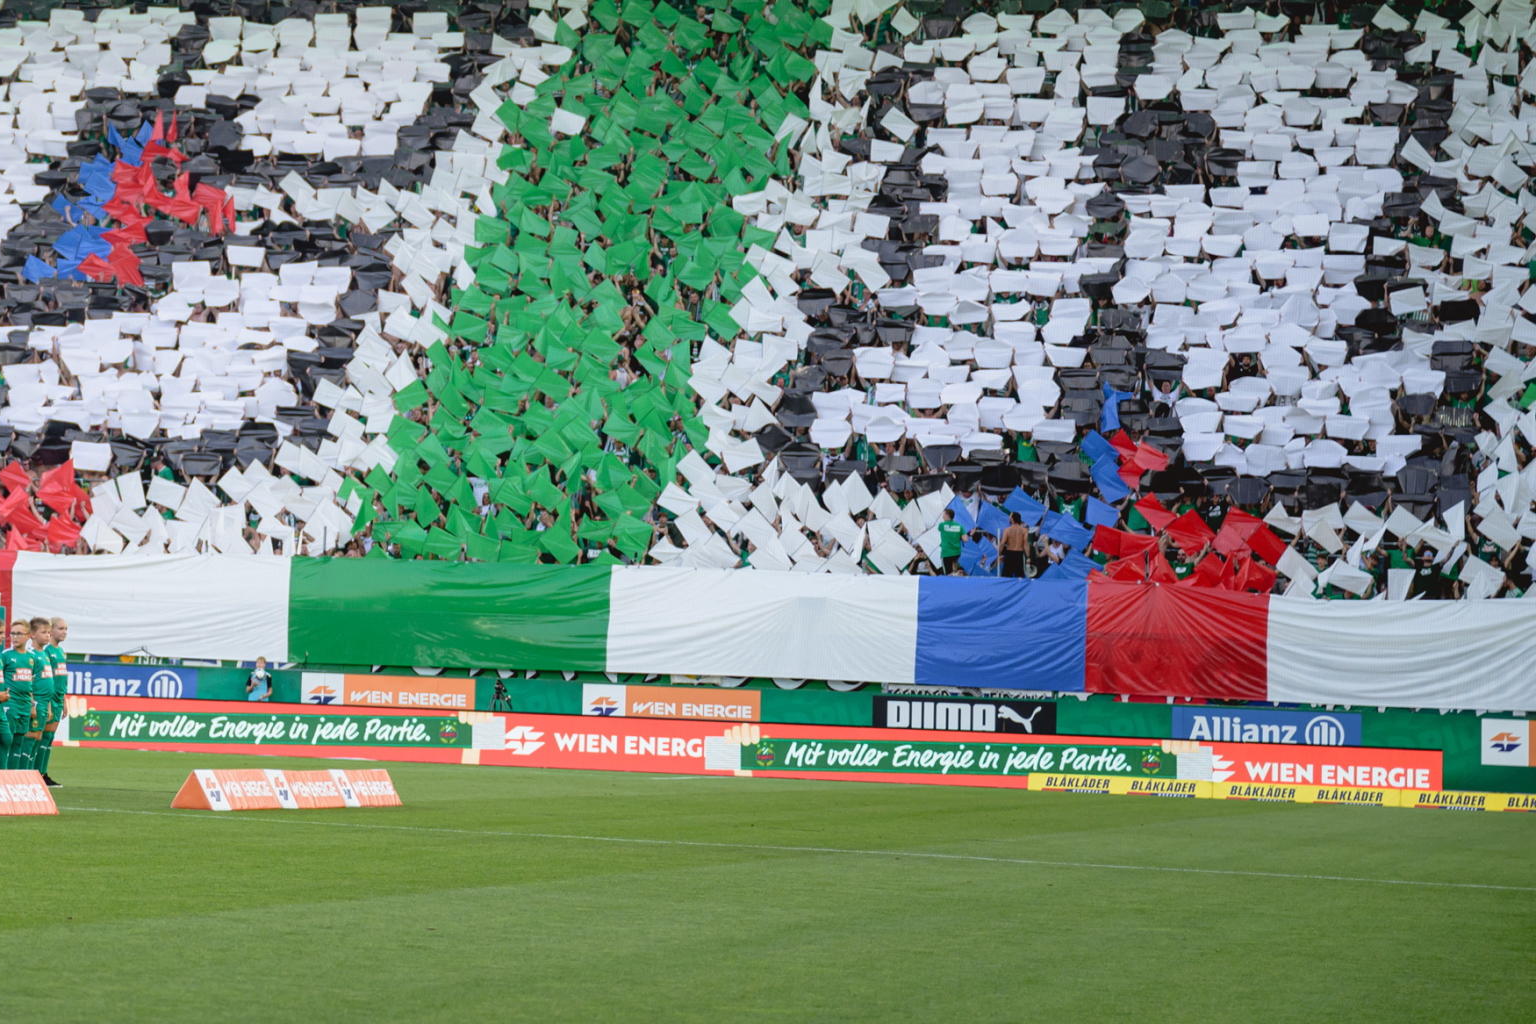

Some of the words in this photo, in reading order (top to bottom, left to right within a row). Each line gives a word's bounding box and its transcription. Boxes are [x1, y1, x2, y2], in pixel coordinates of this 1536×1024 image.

[66, 671, 141, 697] llianz
[350, 689, 391, 704] WIEN
[398, 691, 466, 707] ENERGIE
[632, 701, 676, 715] WIEN
[682, 703, 752, 719] ENERGIE
[886, 700, 996, 732] PUMA
[109, 714, 144, 739] Mit
[149, 718, 205, 740] voller
[209, 716, 287, 745] Energie
[289, 719, 309, 741] in
[311, 720, 361, 746] jede
[365, 721, 431, 742] Partie.
[1189, 715, 1297, 745] Allianz
[553, 732, 616, 754] WIEN
[624, 734, 704, 758] ENERG
[784, 742, 824, 767] Mit
[827, 747, 888, 768] voller
[892, 745, 974, 774] Energie
[979, 746, 999, 769] in
[1002, 745, 1057, 774] jede
[1059, 748, 1132, 773] Partie.
[1244, 761, 1314, 784] WIEN
[1321, 764, 1431, 789] ENERGIE
